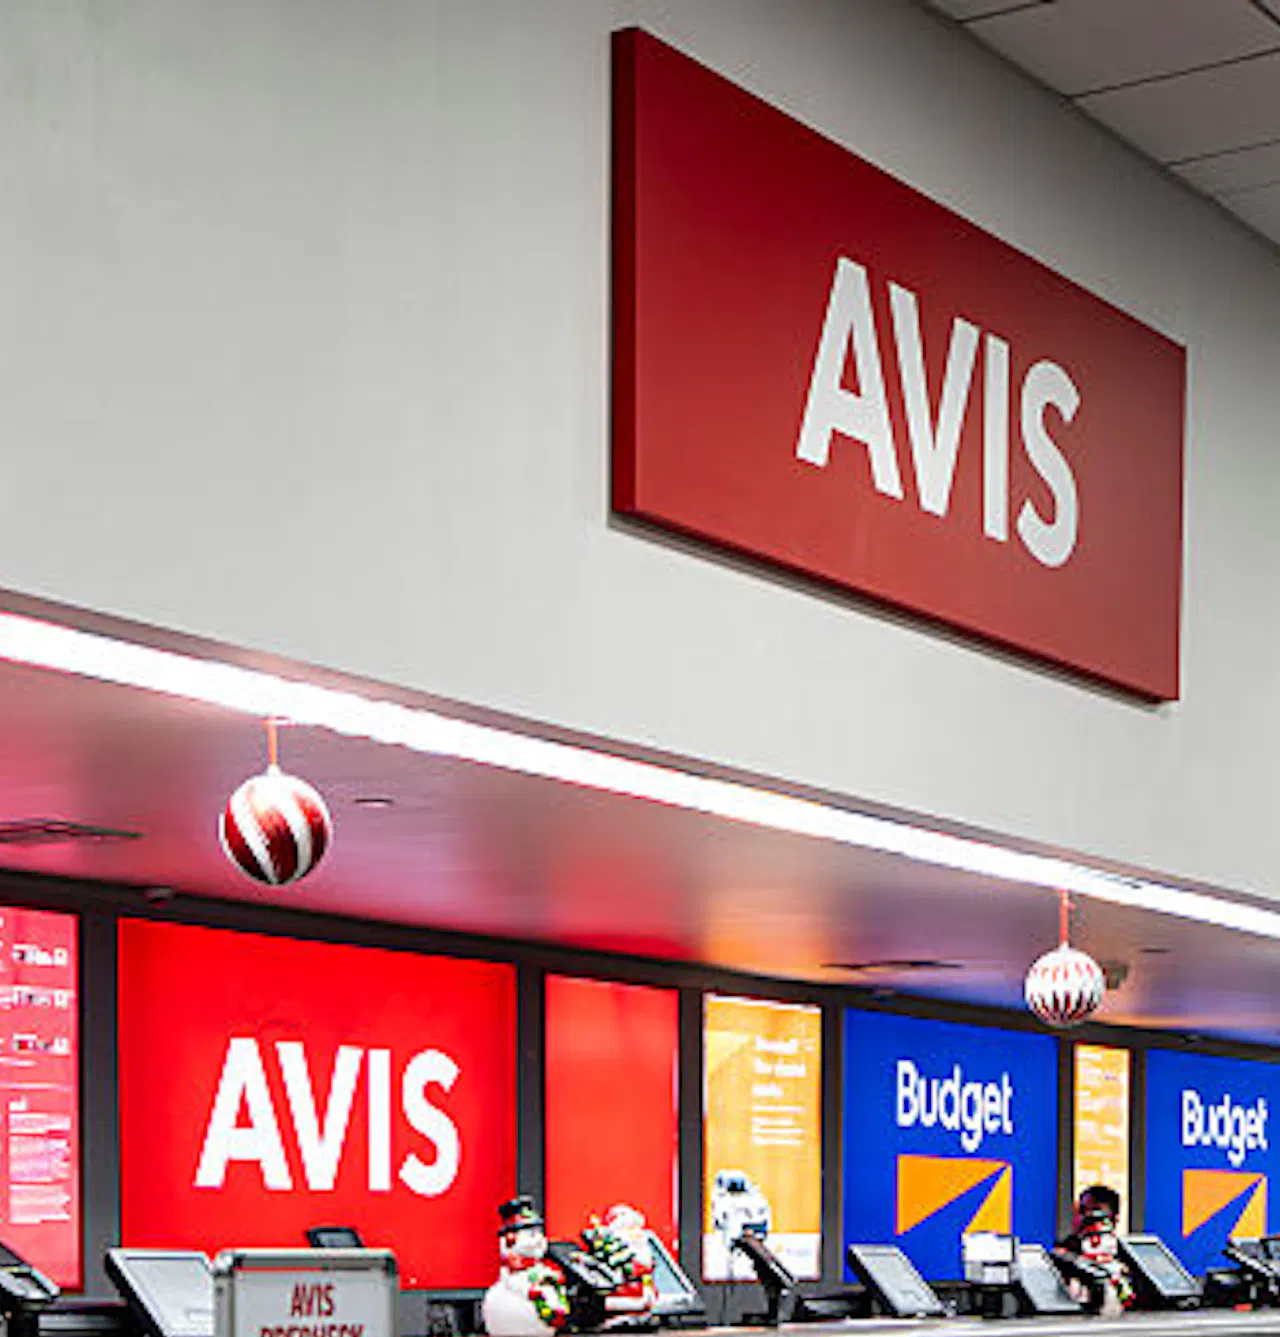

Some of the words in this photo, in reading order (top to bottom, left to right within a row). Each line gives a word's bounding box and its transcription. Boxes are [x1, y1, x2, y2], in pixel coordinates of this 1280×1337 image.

[796, 257, 1080, 567] AVIS
[194, 1036, 460, 1196] AVIS
[896, 1059, 1014, 1151] Budget
[1182, 1088, 1269, 1166] Budget
[291, 1283, 335, 1318] AVIS
